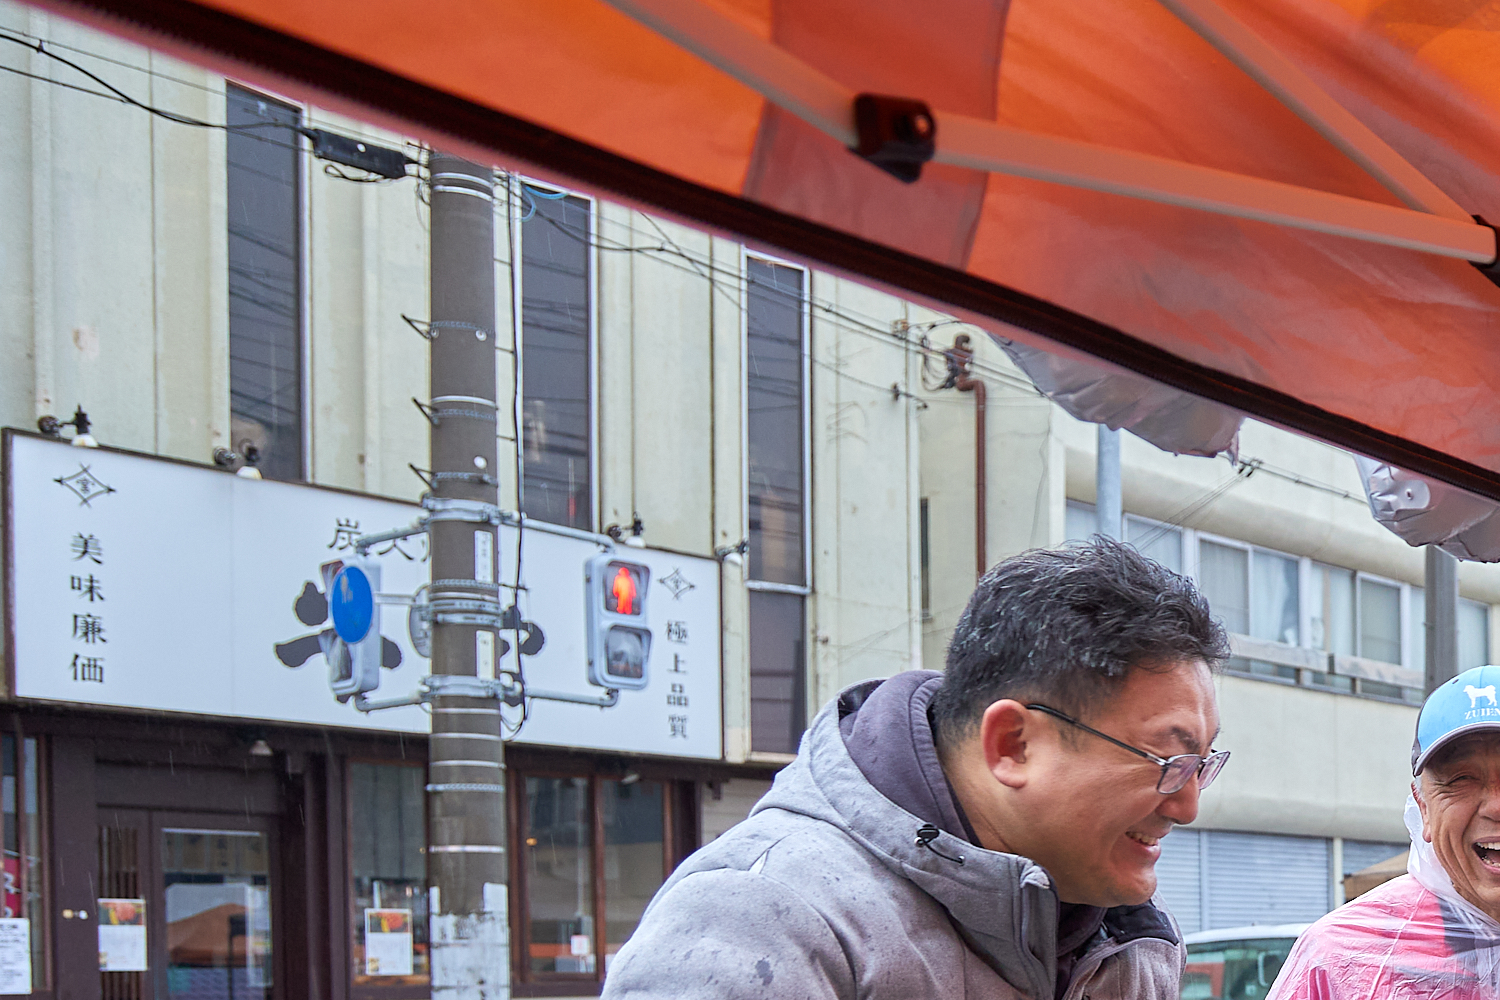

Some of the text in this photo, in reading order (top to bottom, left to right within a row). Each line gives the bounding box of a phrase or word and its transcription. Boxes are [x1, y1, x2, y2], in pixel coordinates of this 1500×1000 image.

[69, 532, 107, 684] 美味廉価
[666, 620, 690, 739] 極上品質
